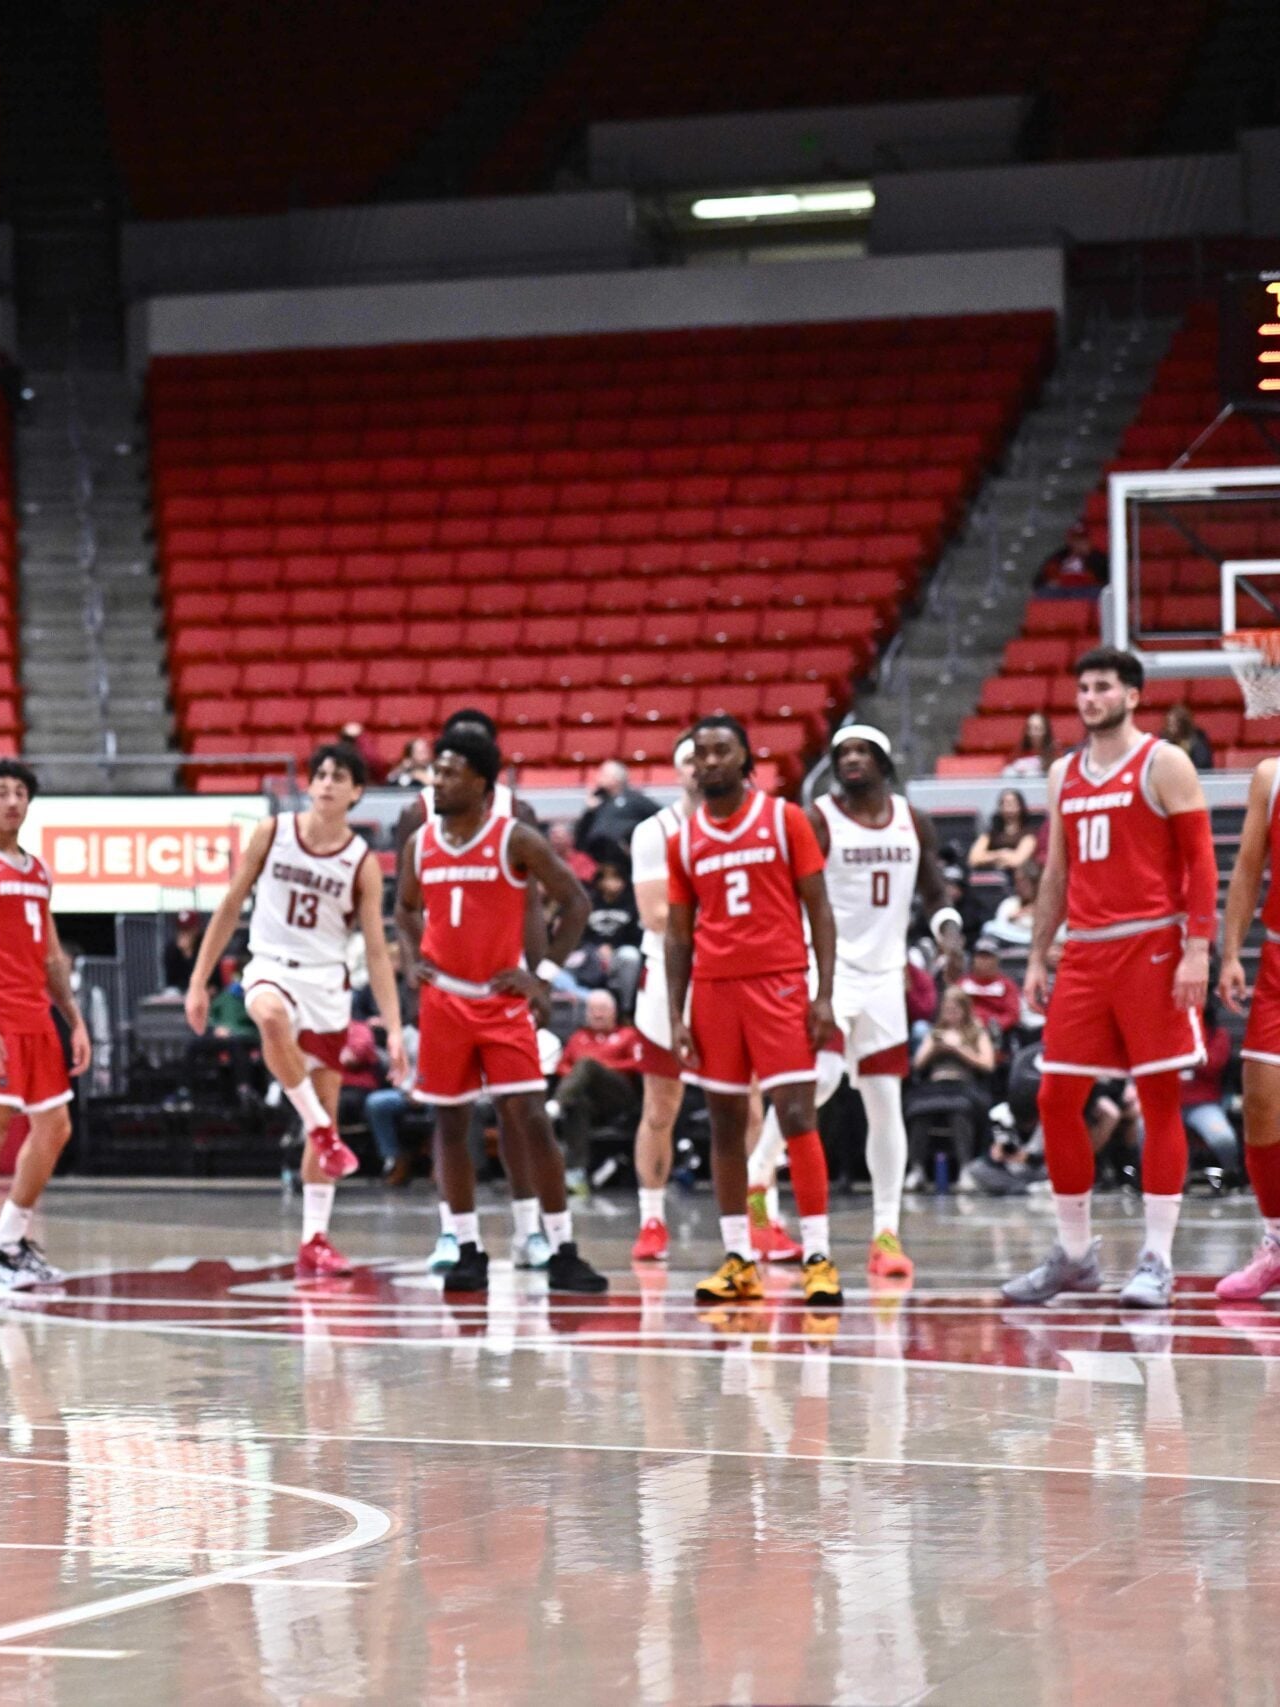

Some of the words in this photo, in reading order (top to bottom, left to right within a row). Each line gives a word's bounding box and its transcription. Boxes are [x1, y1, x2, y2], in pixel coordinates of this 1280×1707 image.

[841, 848, 912, 864] COUGARS
[1077, 813, 1111, 863] 10
[286, 889, 320, 929] 13
[450, 886, 463, 928] 1
[725, 869, 752, 917] 2
[871, 871, 890, 907] 0
[23, 900, 42, 943] 4
